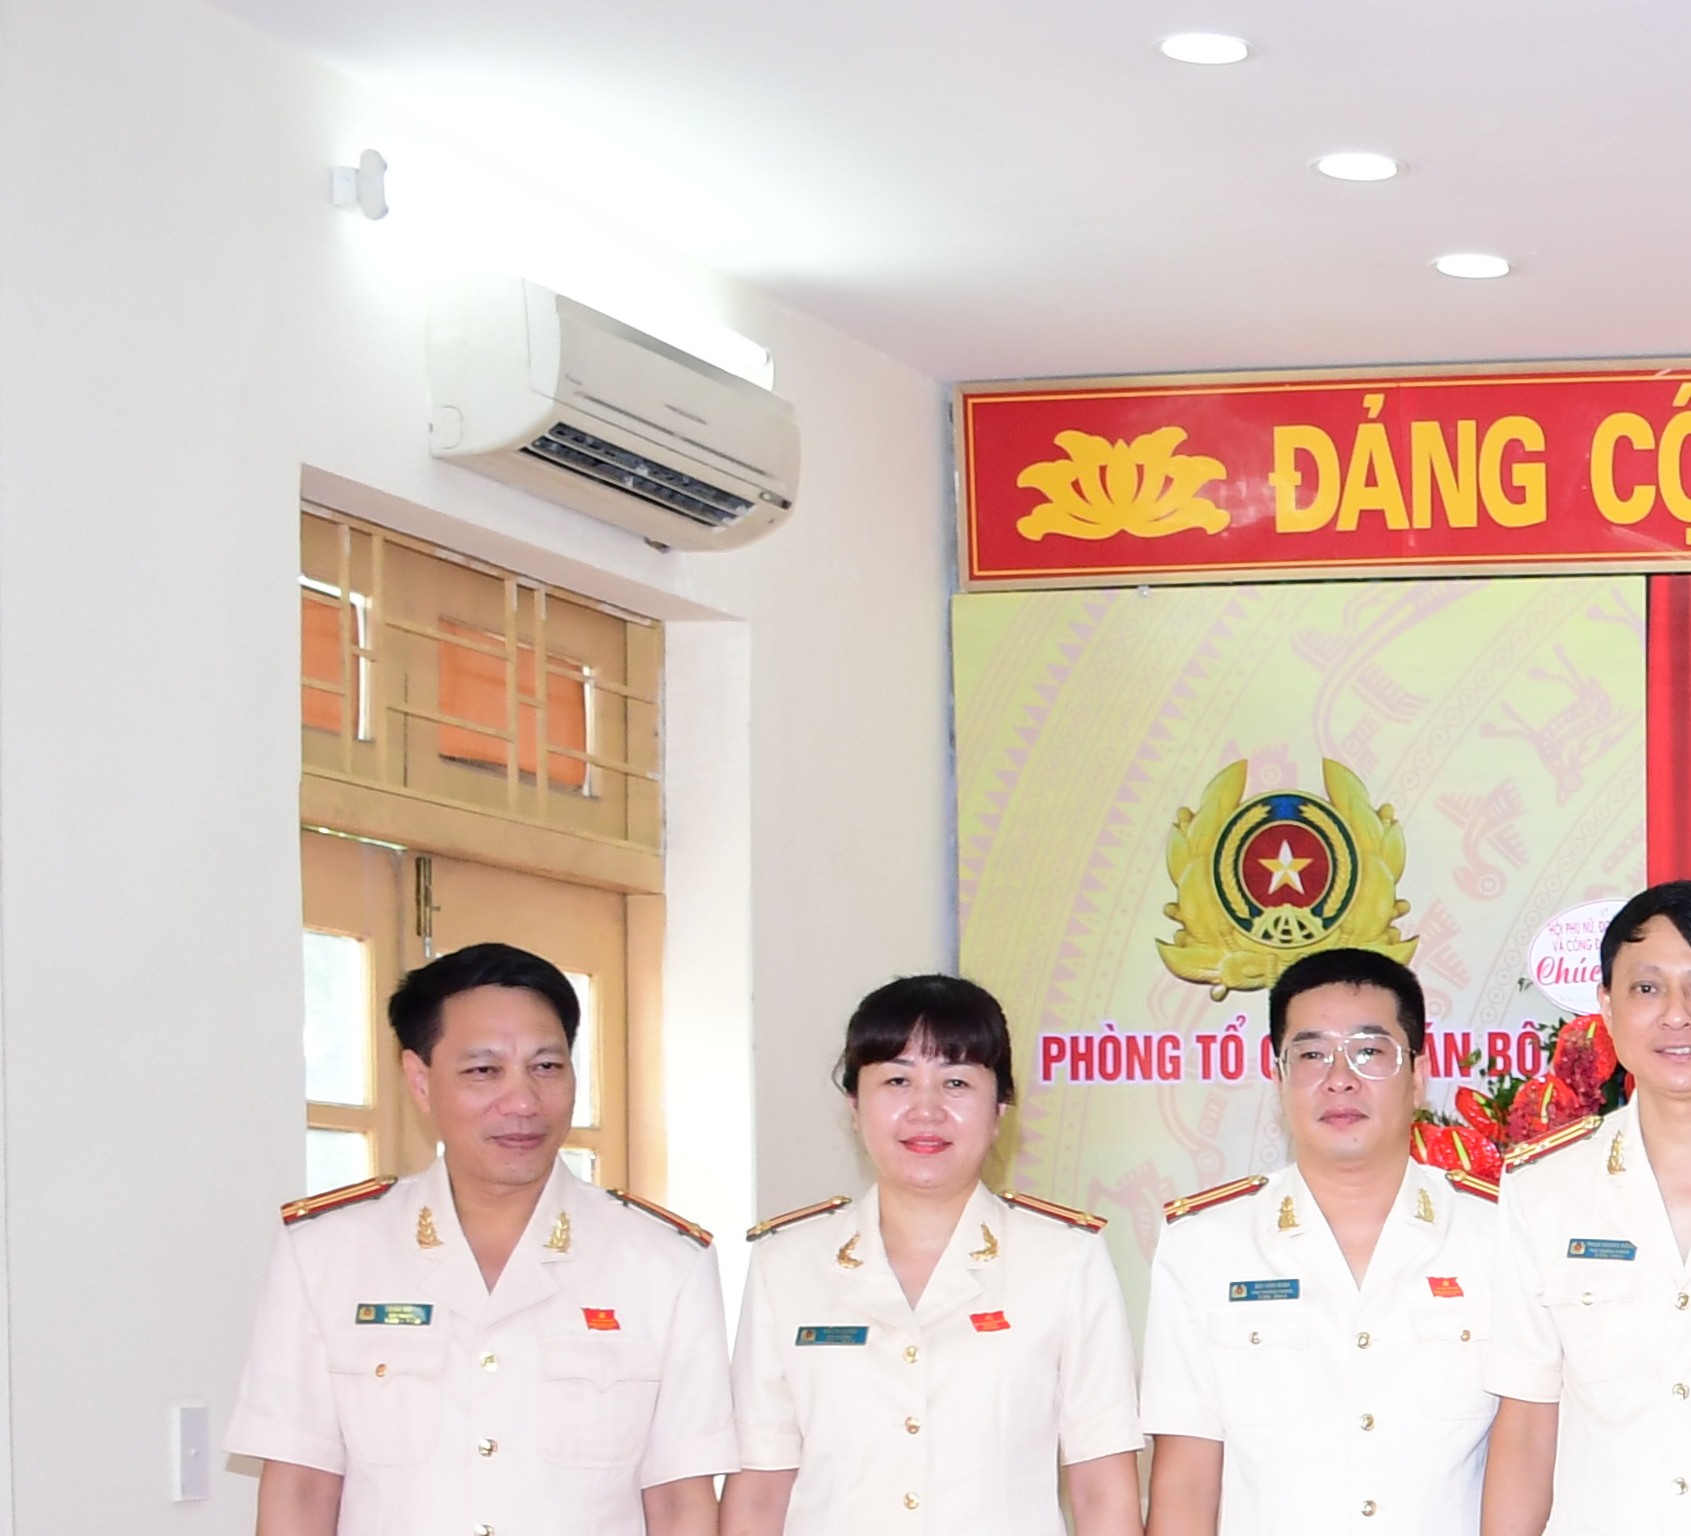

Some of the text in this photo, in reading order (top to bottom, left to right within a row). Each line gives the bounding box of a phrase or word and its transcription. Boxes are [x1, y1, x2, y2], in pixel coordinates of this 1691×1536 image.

[1268, 393, 1546, 533] ĐẢNG
[1042, 1022, 1181, 1081] PHÒNG
[1195, 1014, 1246, 1081] TỔ
